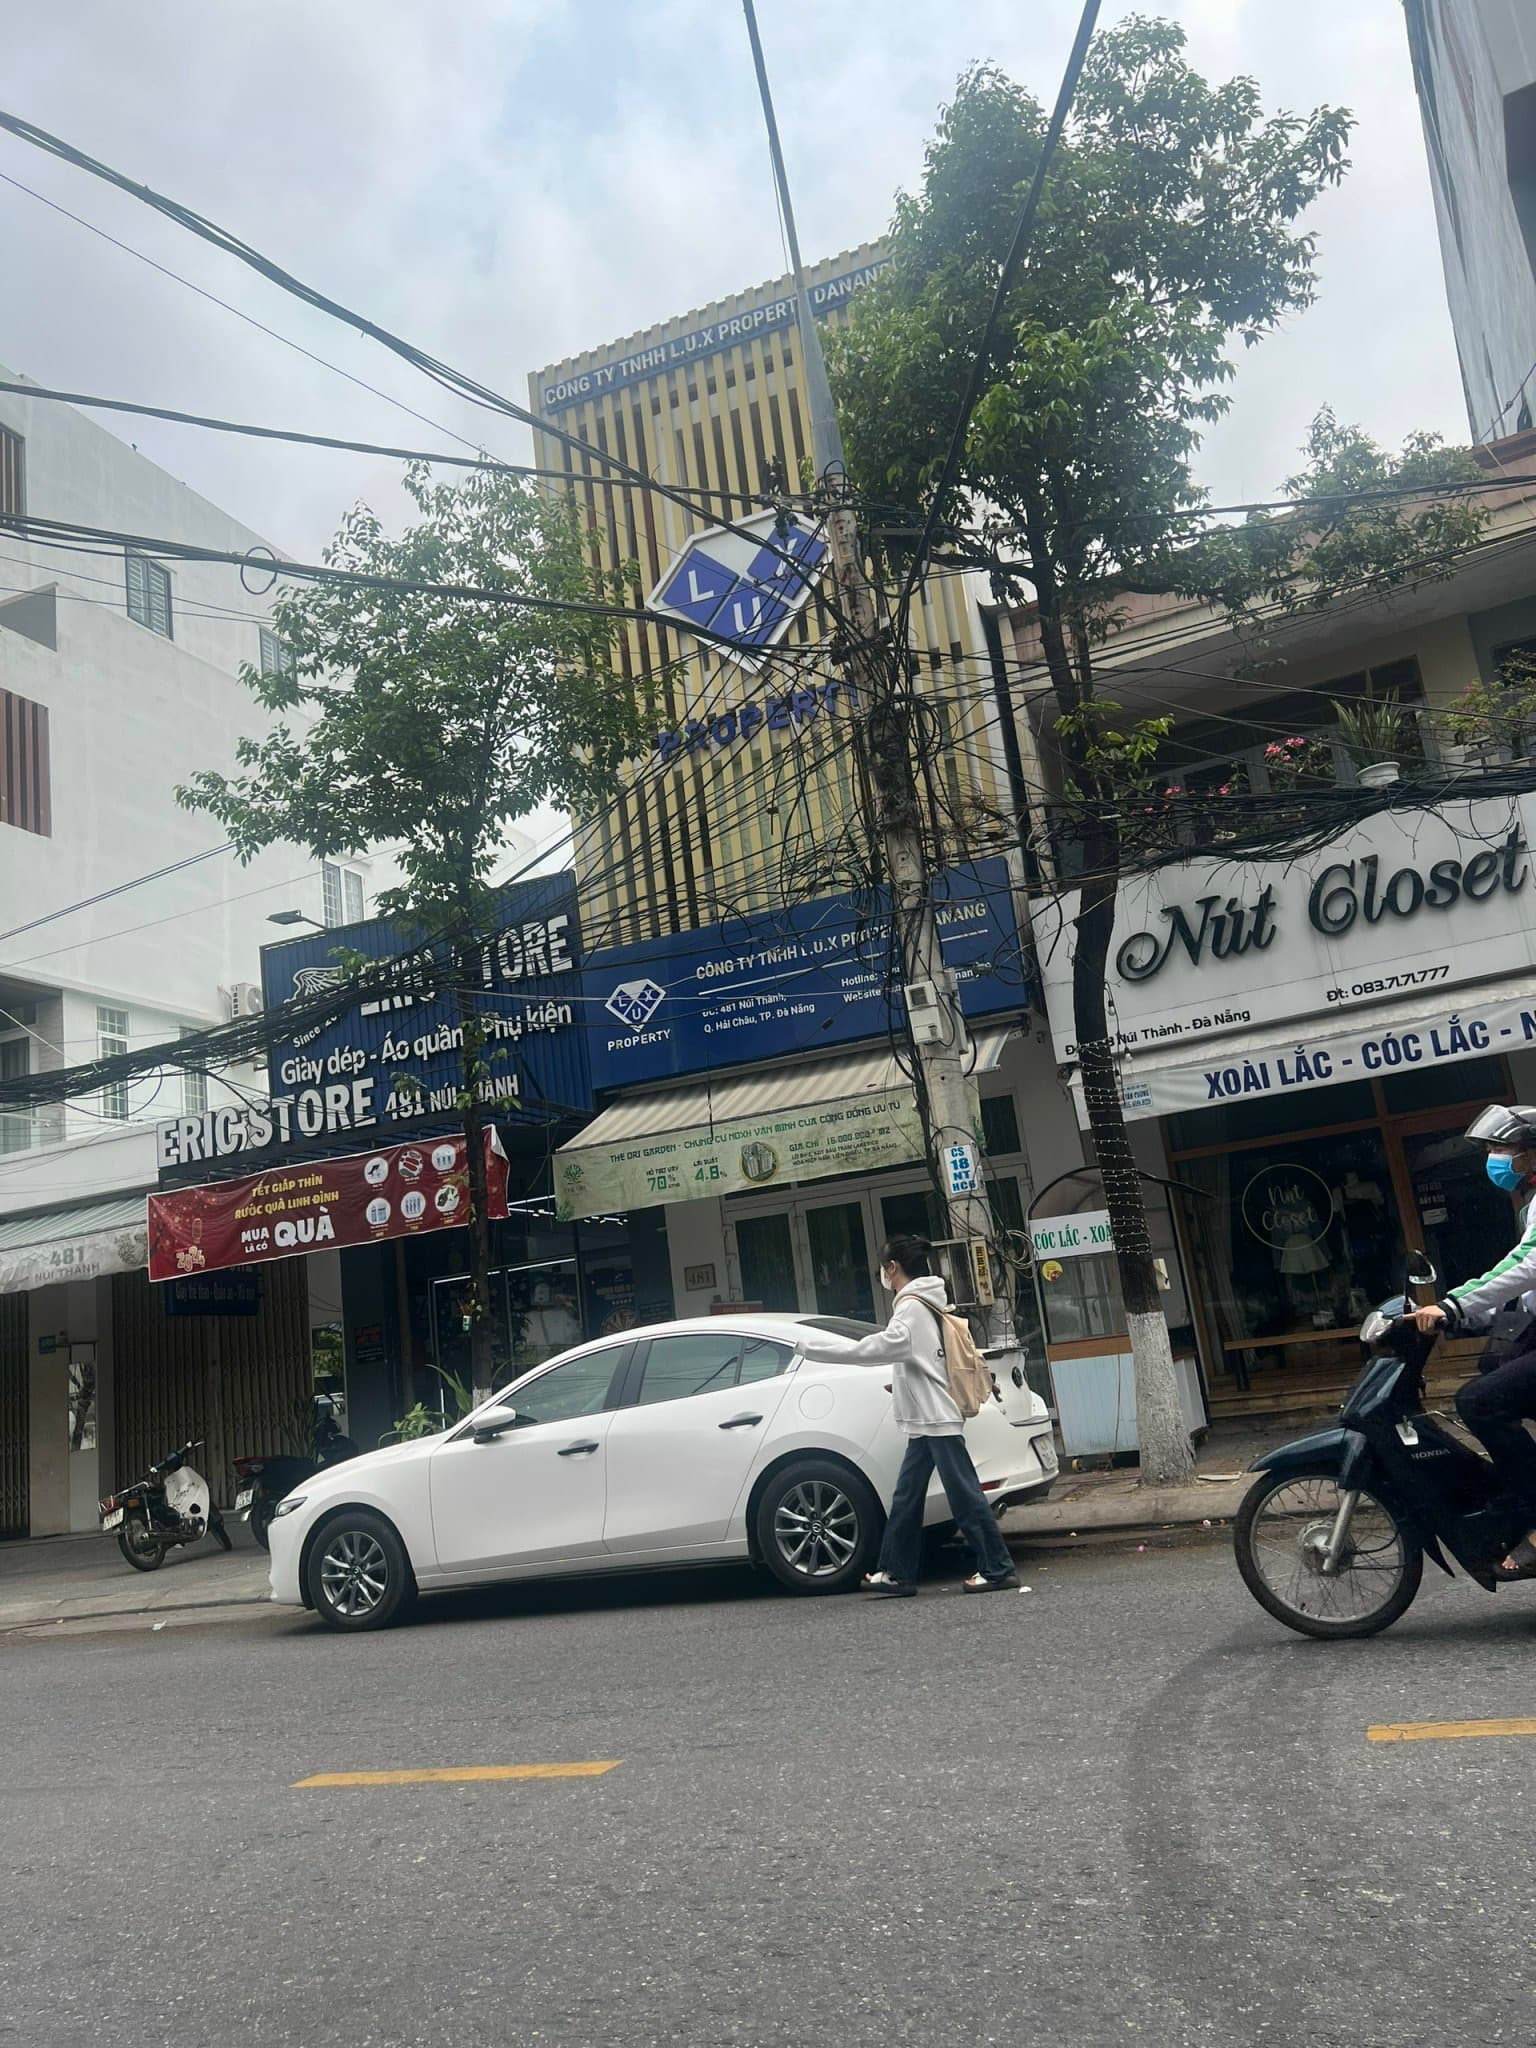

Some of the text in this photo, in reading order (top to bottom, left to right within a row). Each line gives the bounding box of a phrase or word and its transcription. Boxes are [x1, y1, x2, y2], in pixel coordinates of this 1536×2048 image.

[593, 366, 615, 386] TY
[619, 347, 666, 377] TNHH
[670, 328, 713, 358] L.U.X
[718, 296, 798, 340] PROPERT
[1116, 821, 1528, 982] Nút Closet
[696, 960, 734, 980] CÔNG
[737, 954, 755, 970] TY
[758, 944, 798, 966] TNHH
[841, 972, 878, 988] Hotline:
[1326, 965, 1450, 1001] Đt: 083.71.71.777
[704, 1003, 815, 1033] Q. Hải Châu, TP. Đà Nẵng
[720, 1002, 736, 1014] 481
[739, 998, 754, 1010] Núi
[293, 1026, 320, 1047] Since
[1141, 1023, 1183, 1040] Thành
[1192, 1015, 1212, 1030] Đà
[1214, 1009, 1251, 1027] Nẵng
[280, 1055, 324, 1085] Giày
[327, 1045, 366, 1075] dép
[381, 1030, 410, 1063] Áo
[413, 1023, 464, 1061] quần
[526, 1001, 572, 1033] kiện
[607, 1028, 671, 1052] PROPERTY
[1203, 1060, 1271, 1099] XOÀI
[1277, 1044, 1333, 1085] LẮC
[1361, 1032, 1423, 1071] CÓC
[1429, 1014, 1490, 1057] LẮC
[385, 1087, 425, 1120] 481
[610, 1154, 625, 1163] THE
[643, 1144, 677, 1157] GARDEN
[951, 1147, 965, 1157] CS
[951, 1157, 970, 1170] 18
[252, 1173, 324, 1197] TẾT GIÁP THÌN
[953, 1170, 970, 1181] NT
[265, 1198, 286, 1214] QUÀ
[287, 1196, 311, 1209] LINH
[311, 1191, 340, 1204] ĐÌNH
[241, 1227, 270, 1243] MUA
[274, 1206, 336, 1247] QUÀ
[1034, 1228, 1055, 1250] CÓC
[1059, 1223, 1081, 1248] LẮC
[50, 1246, 84, 1266] 481
[256, 1242, 269, 1251] CÓ
[1411, 1449, 1451, 1461] HONDA
